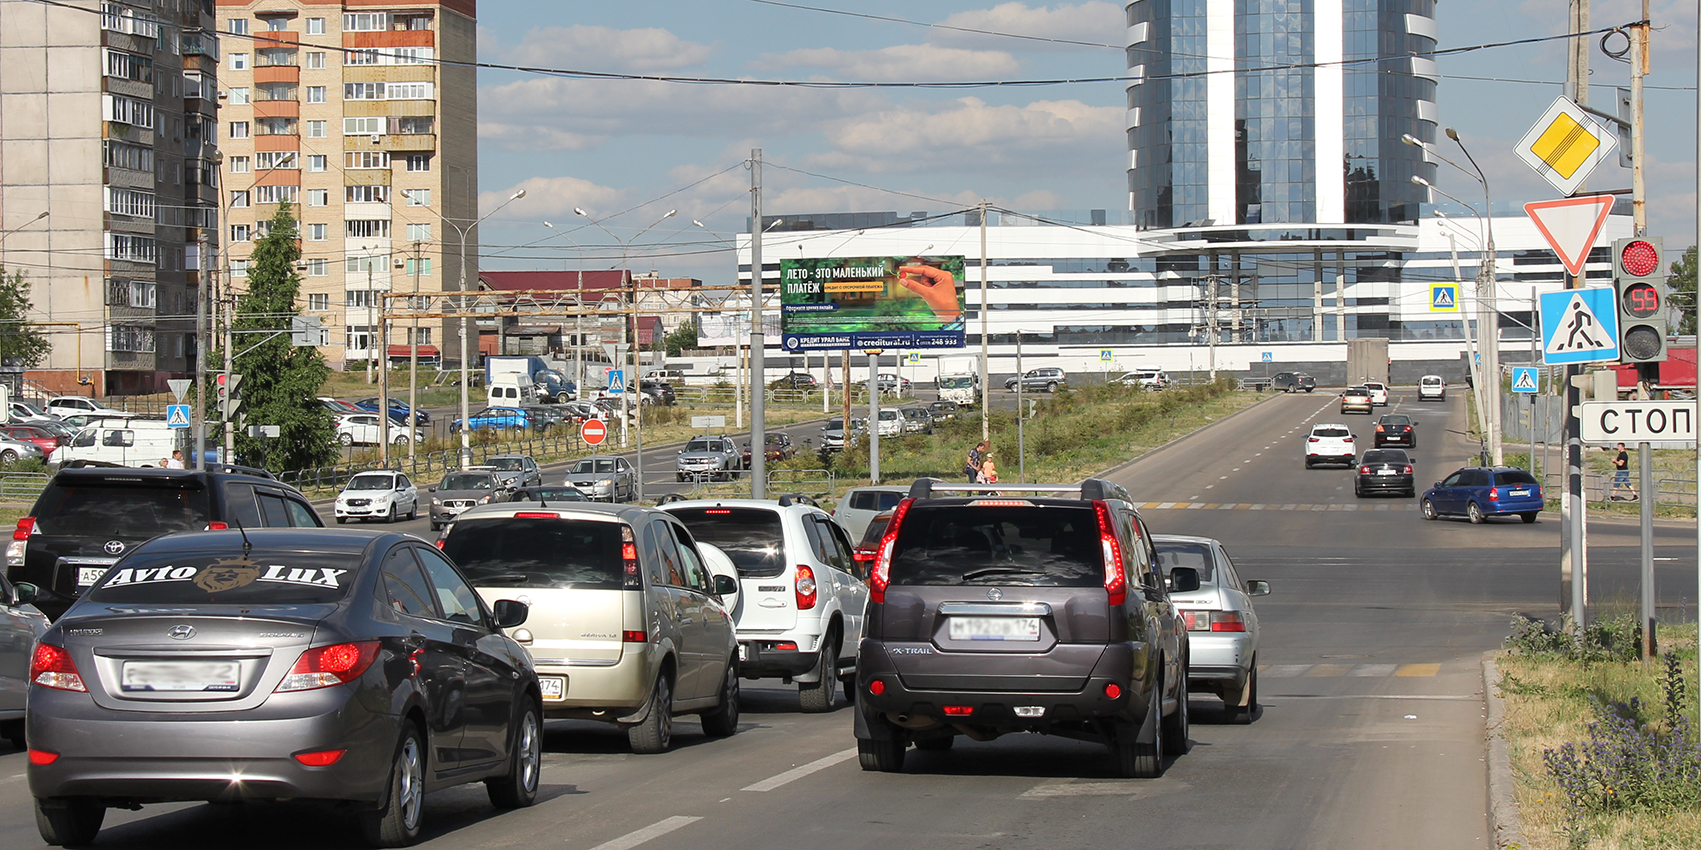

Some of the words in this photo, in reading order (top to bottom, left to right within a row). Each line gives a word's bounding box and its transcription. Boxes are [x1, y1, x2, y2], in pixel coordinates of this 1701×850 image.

[787, 268, 808, 280] ЛЕТО
[815, 267, 831, 279] ЭТО
[832, 264, 884, 279] МАЛЕНЬКИЙ
[787, 281, 820, 294] ПЛАТЁЖ
[1631, 288, 1658, 311] 59
[1600, 408, 1690, 434] СТОП
[103, 564, 198, 587] Avto
[893, 647, 933, 655] X-TRAIL
